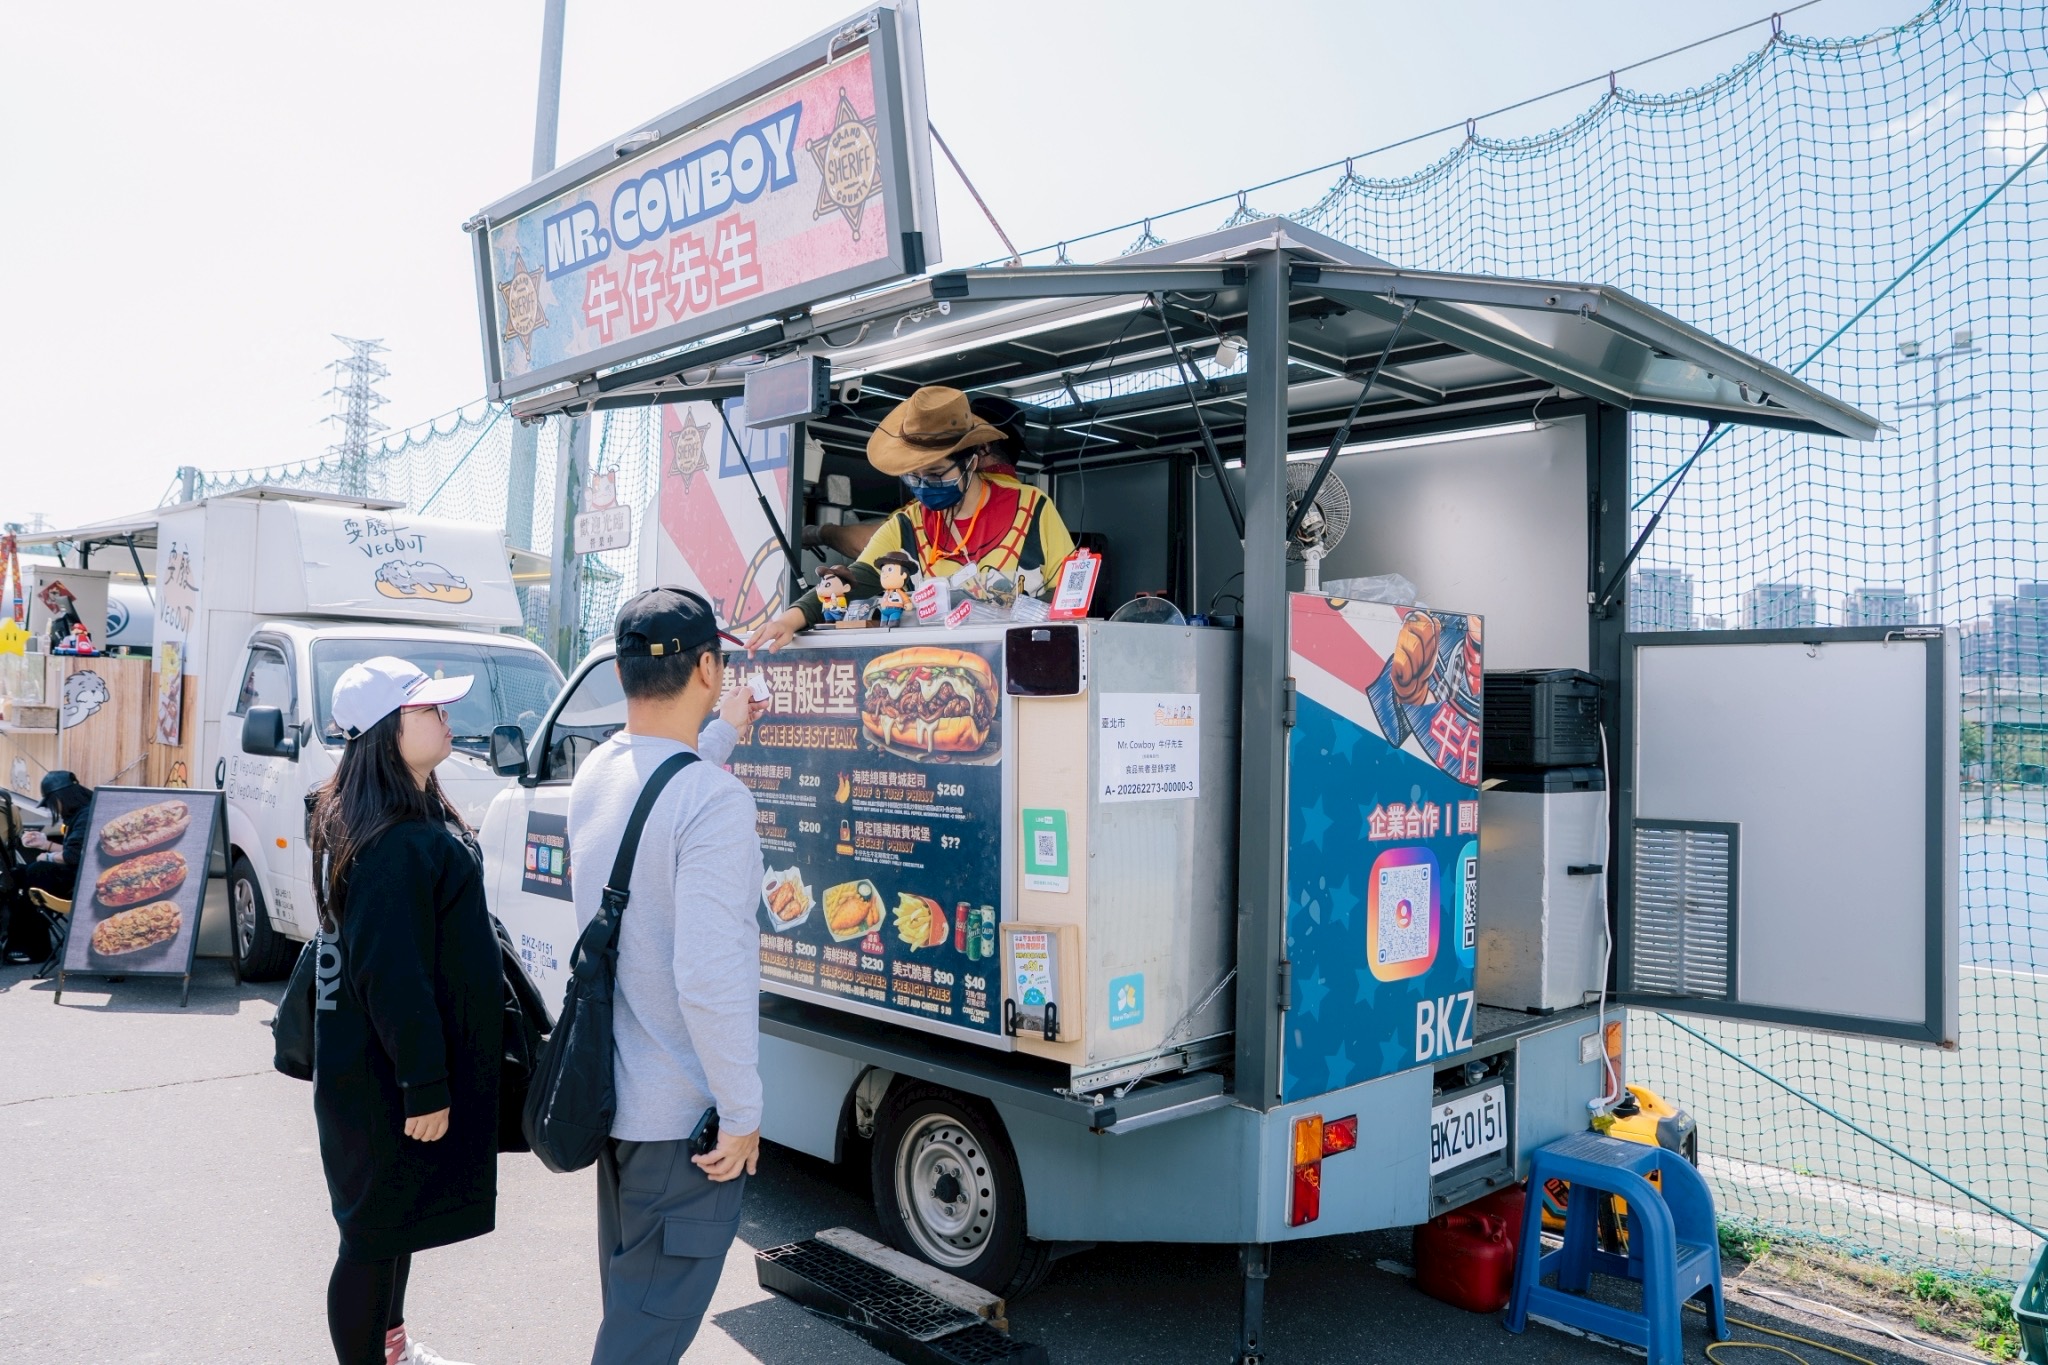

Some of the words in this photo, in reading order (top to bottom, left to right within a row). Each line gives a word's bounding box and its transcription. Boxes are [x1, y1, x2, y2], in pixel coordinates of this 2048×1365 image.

[832, 127, 861, 148] GRAND
[828, 145, 871, 186] SHERIFF
[547, 208, 610, 274] MR.
[613, 112, 800, 242] COWBOY
[837, 179, 868, 203] COUNTY
[587, 224, 755, 336] 牛仔先生
[510, 291, 535, 319] SHERIFF
[1101, 717, 1126, 729] 臺北市
[758, 724, 859, 750] CHEESESTEAK
[1117, 741, 1128, 750] Mr.
[1129, 740, 1156, 751] Cowboy
[1158, 739, 1183, 748] 牛仔先生
[1432, 707, 1480, 782] 牛仔
[799, 774, 821, 788] $220
[852, 769, 927, 788] 海陸總匯費城起司
[852, 786, 873, 799] SURF
[883, 788, 904, 800] TURF
[937, 782, 965, 797] $260
[799, 819, 821, 834] $200
[1369, 803, 1440, 840] 企業合作
[1459, 802, 1479, 834] 團
[855, 837, 884, 850] SECRET
[940, 834, 961, 850] $??
[521, 934, 553, 956] BKZ-0151
[795, 941, 817, 957] $200
[796, 959, 816, 974] FRIES
[861, 954, 884, 971] $230
[820, 963, 854, 982] SEAFOOD
[934, 968, 955, 986] $90
[964, 973, 986, 991] $40
[892, 978, 925, 998] FRENCH
[926, 985, 951, 1003] FRIES
[921, 1001, 939, 1013] CHEESE
[1415, 991, 1474, 1062] BKZ
[1430, 1101, 1503, 1164] BKZ-0151
